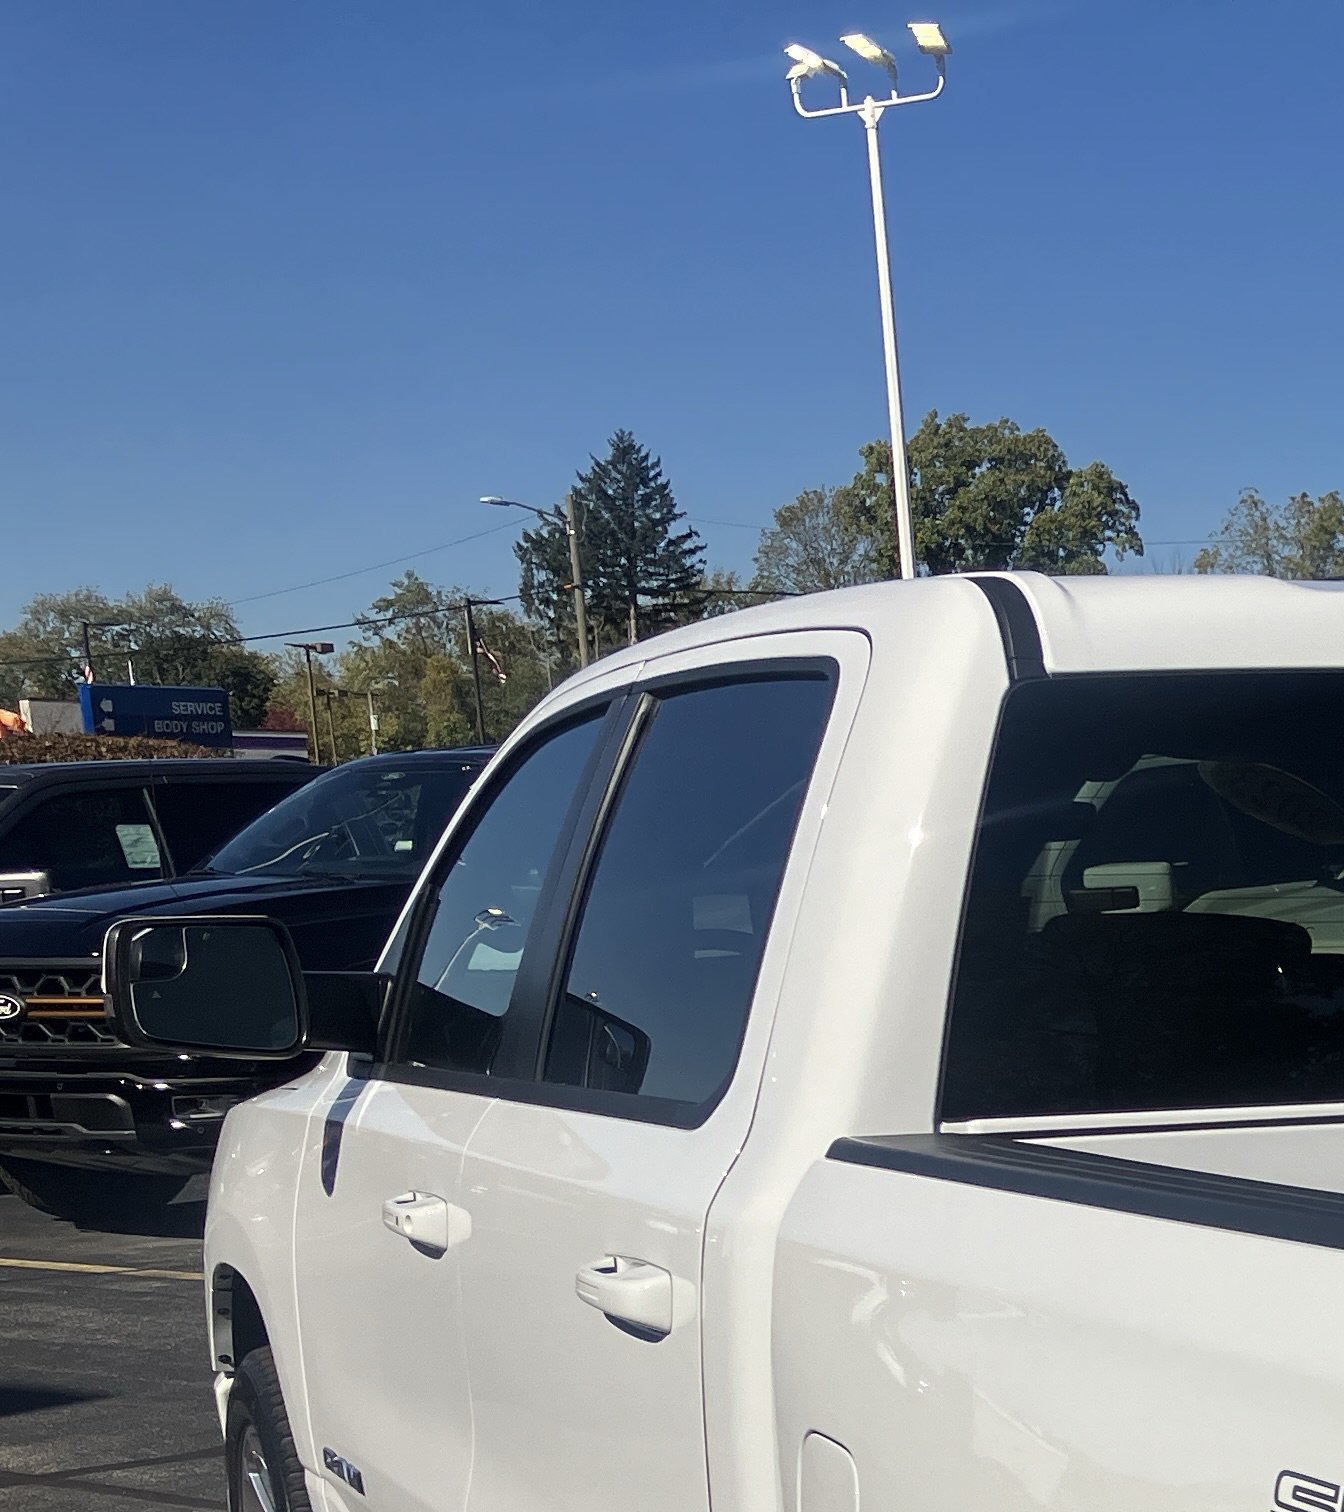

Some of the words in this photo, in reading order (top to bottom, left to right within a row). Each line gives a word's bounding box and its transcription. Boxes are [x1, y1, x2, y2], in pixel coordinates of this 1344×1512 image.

[171, 701, 224, 716] SERVICE
[154, 720, 188, 734] BODY
[191, 720, 225, 734] SHOP
